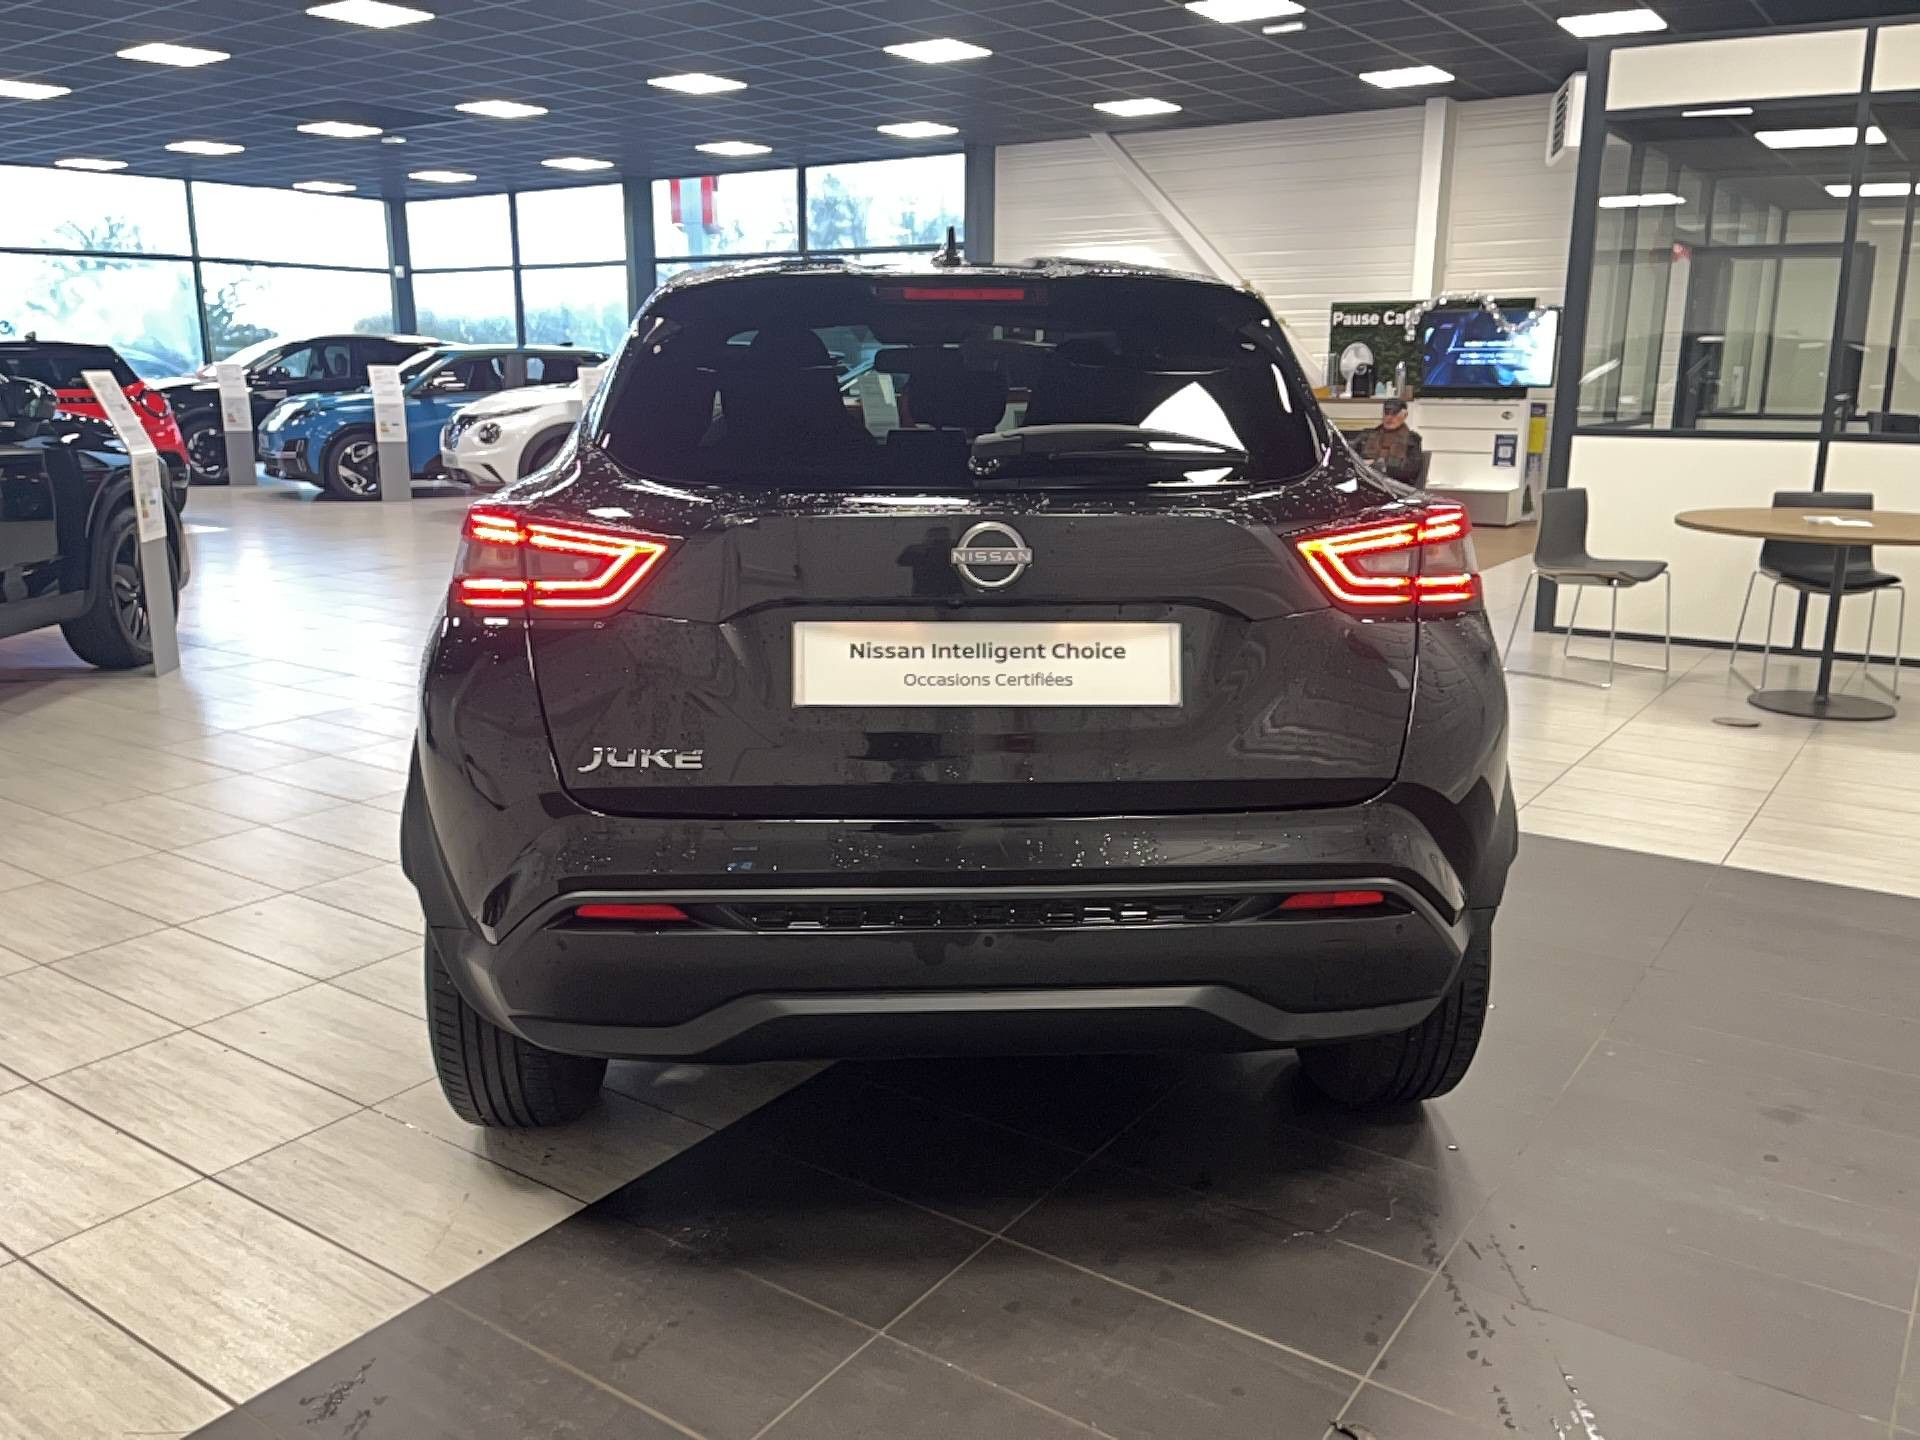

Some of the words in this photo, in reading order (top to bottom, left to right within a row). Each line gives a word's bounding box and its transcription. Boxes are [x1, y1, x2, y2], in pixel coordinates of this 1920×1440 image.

[1332, 311, 1379, 326] Pause
[952, 551, 1031, 562] NISSAN
[849, 642, 925, 659] Nissan
[931, 642, 1046, 664] Intelligent
[1051, 642, 1126, 659] Choice
[903, 673, 990, 686] Occasions
[995, 671, 1073, 686] Certifiées
[577, 747, 703, 772] JUKE
